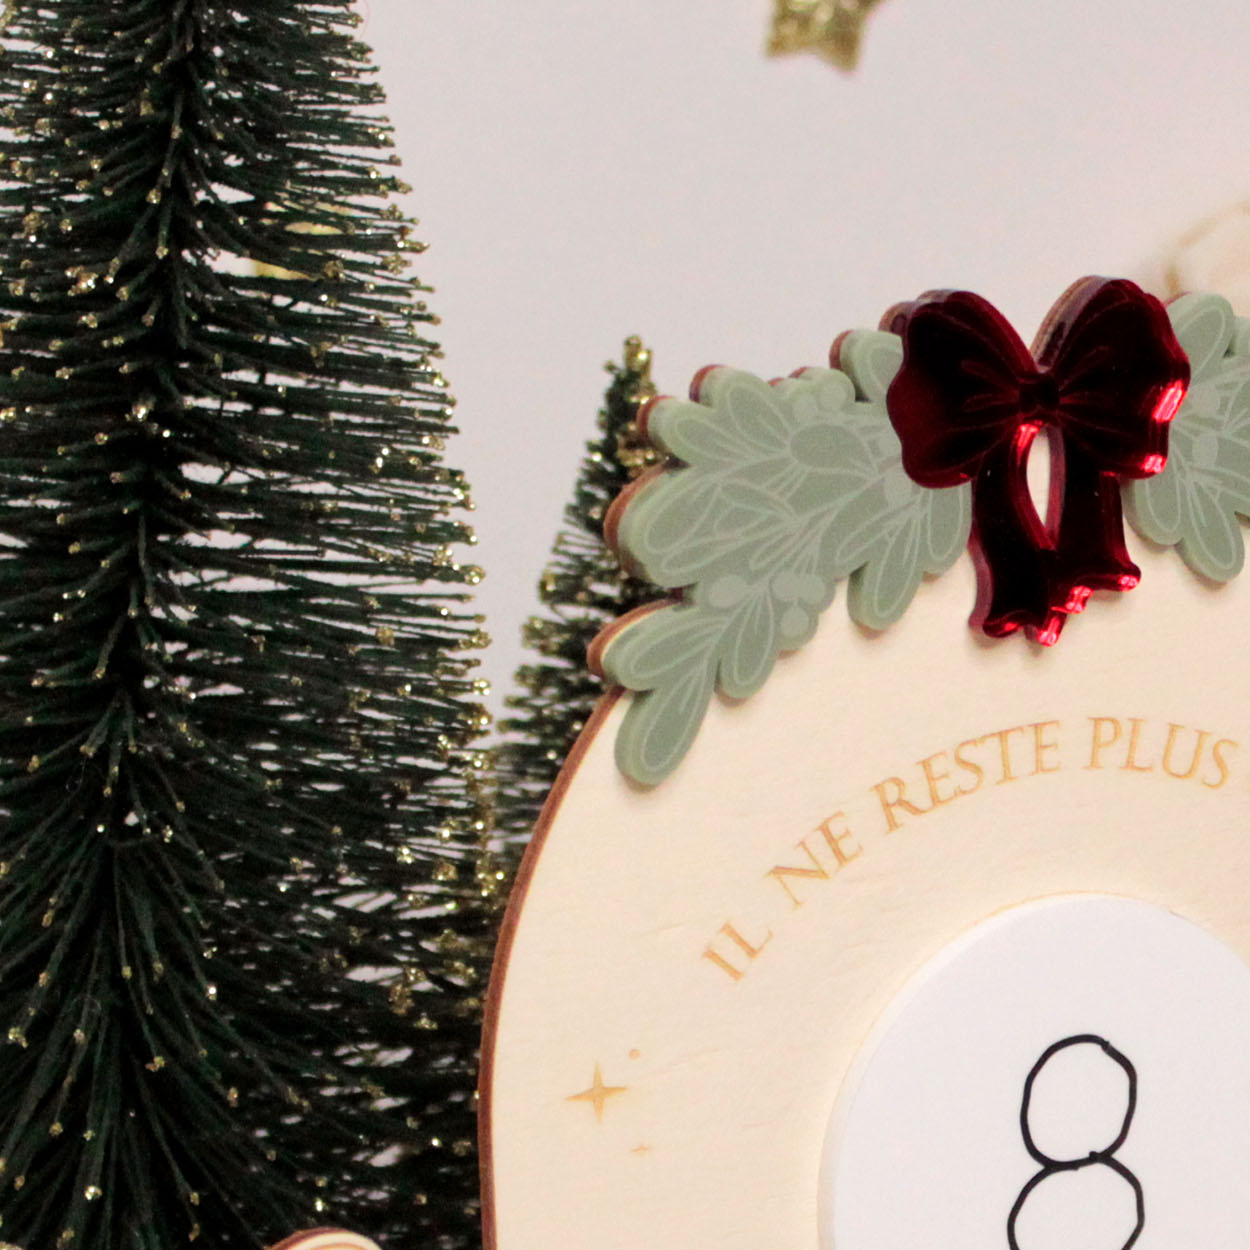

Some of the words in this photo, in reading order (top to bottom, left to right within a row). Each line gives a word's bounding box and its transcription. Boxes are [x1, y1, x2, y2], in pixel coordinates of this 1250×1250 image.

[702, 919, 773, 982] IL
[765, 812, 863, 909] NE
[869, 719, 1062, 835] RESTE
[1084, 716, 1239, 790] PLUS
